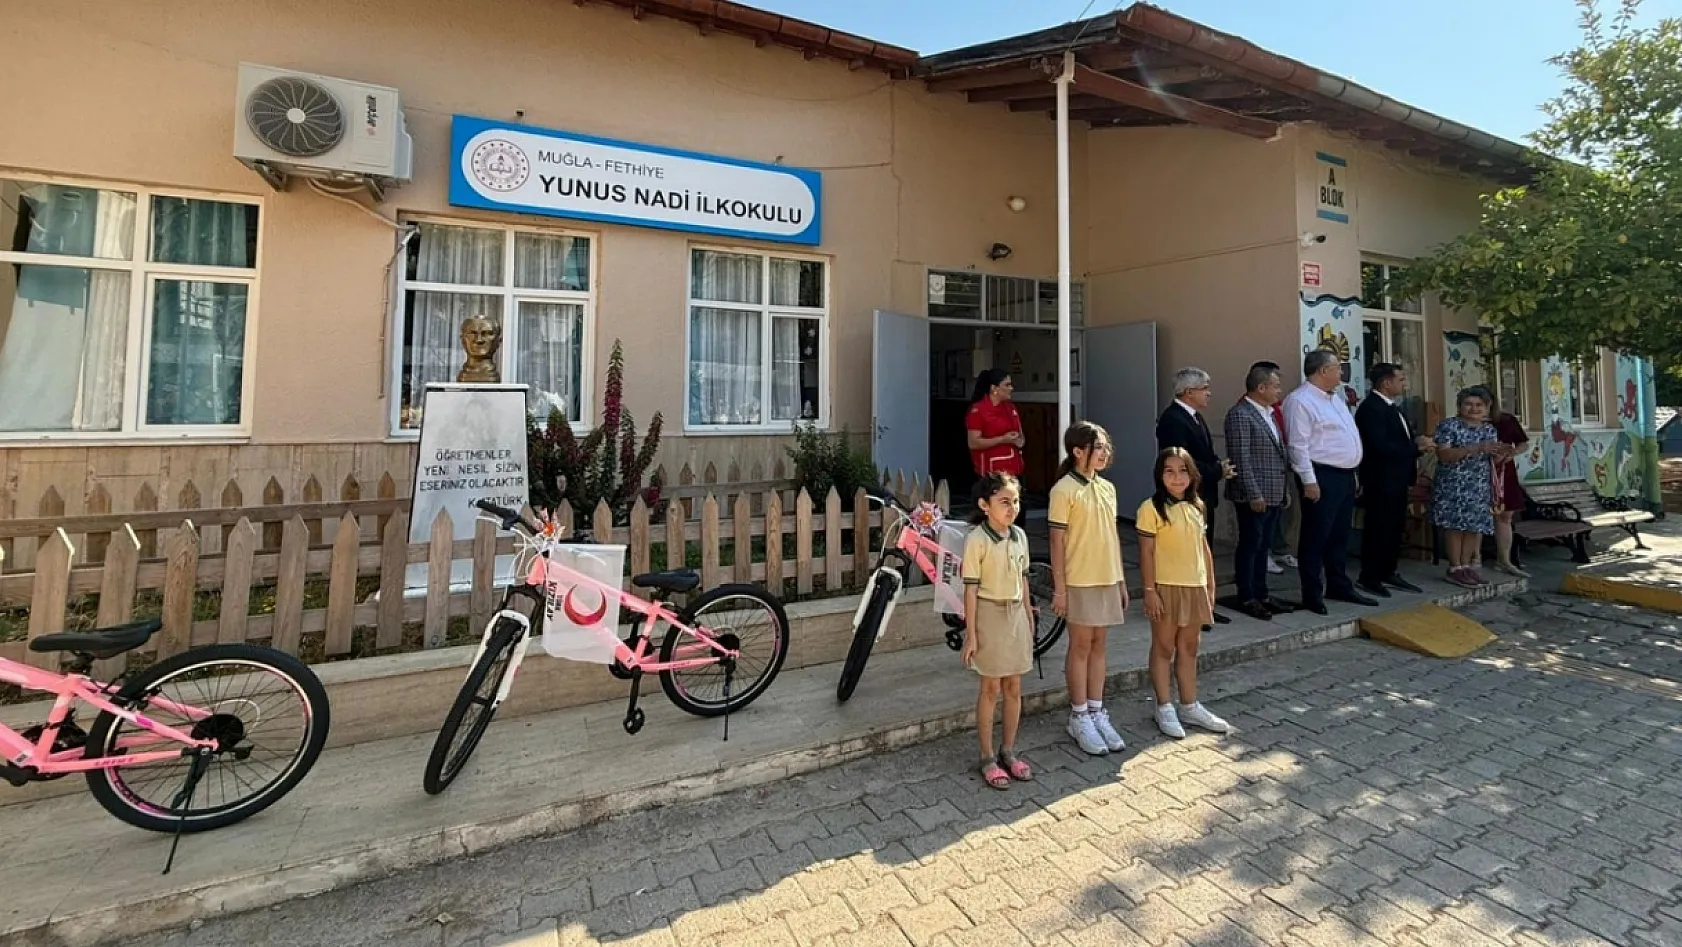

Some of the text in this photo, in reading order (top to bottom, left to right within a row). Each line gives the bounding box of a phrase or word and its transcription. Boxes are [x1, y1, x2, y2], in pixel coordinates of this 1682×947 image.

[538, 150, 593, 169] MUĞLA
[604, 159, 664, 179] FETHİYE
[1328, 167, 1336, 185] A
[539, 174, 802, 225] YUNUS NADİ İLKOKULU
[1320, 185, 1344, 208] BLOK
[436, 448, 511, 461] ÖĞRETMENLER
[458, 463, 489, 474] NESİL
[495, 461, 522, 473] SİZİN
[469, 476, 524, 488] OLACAKTIR
